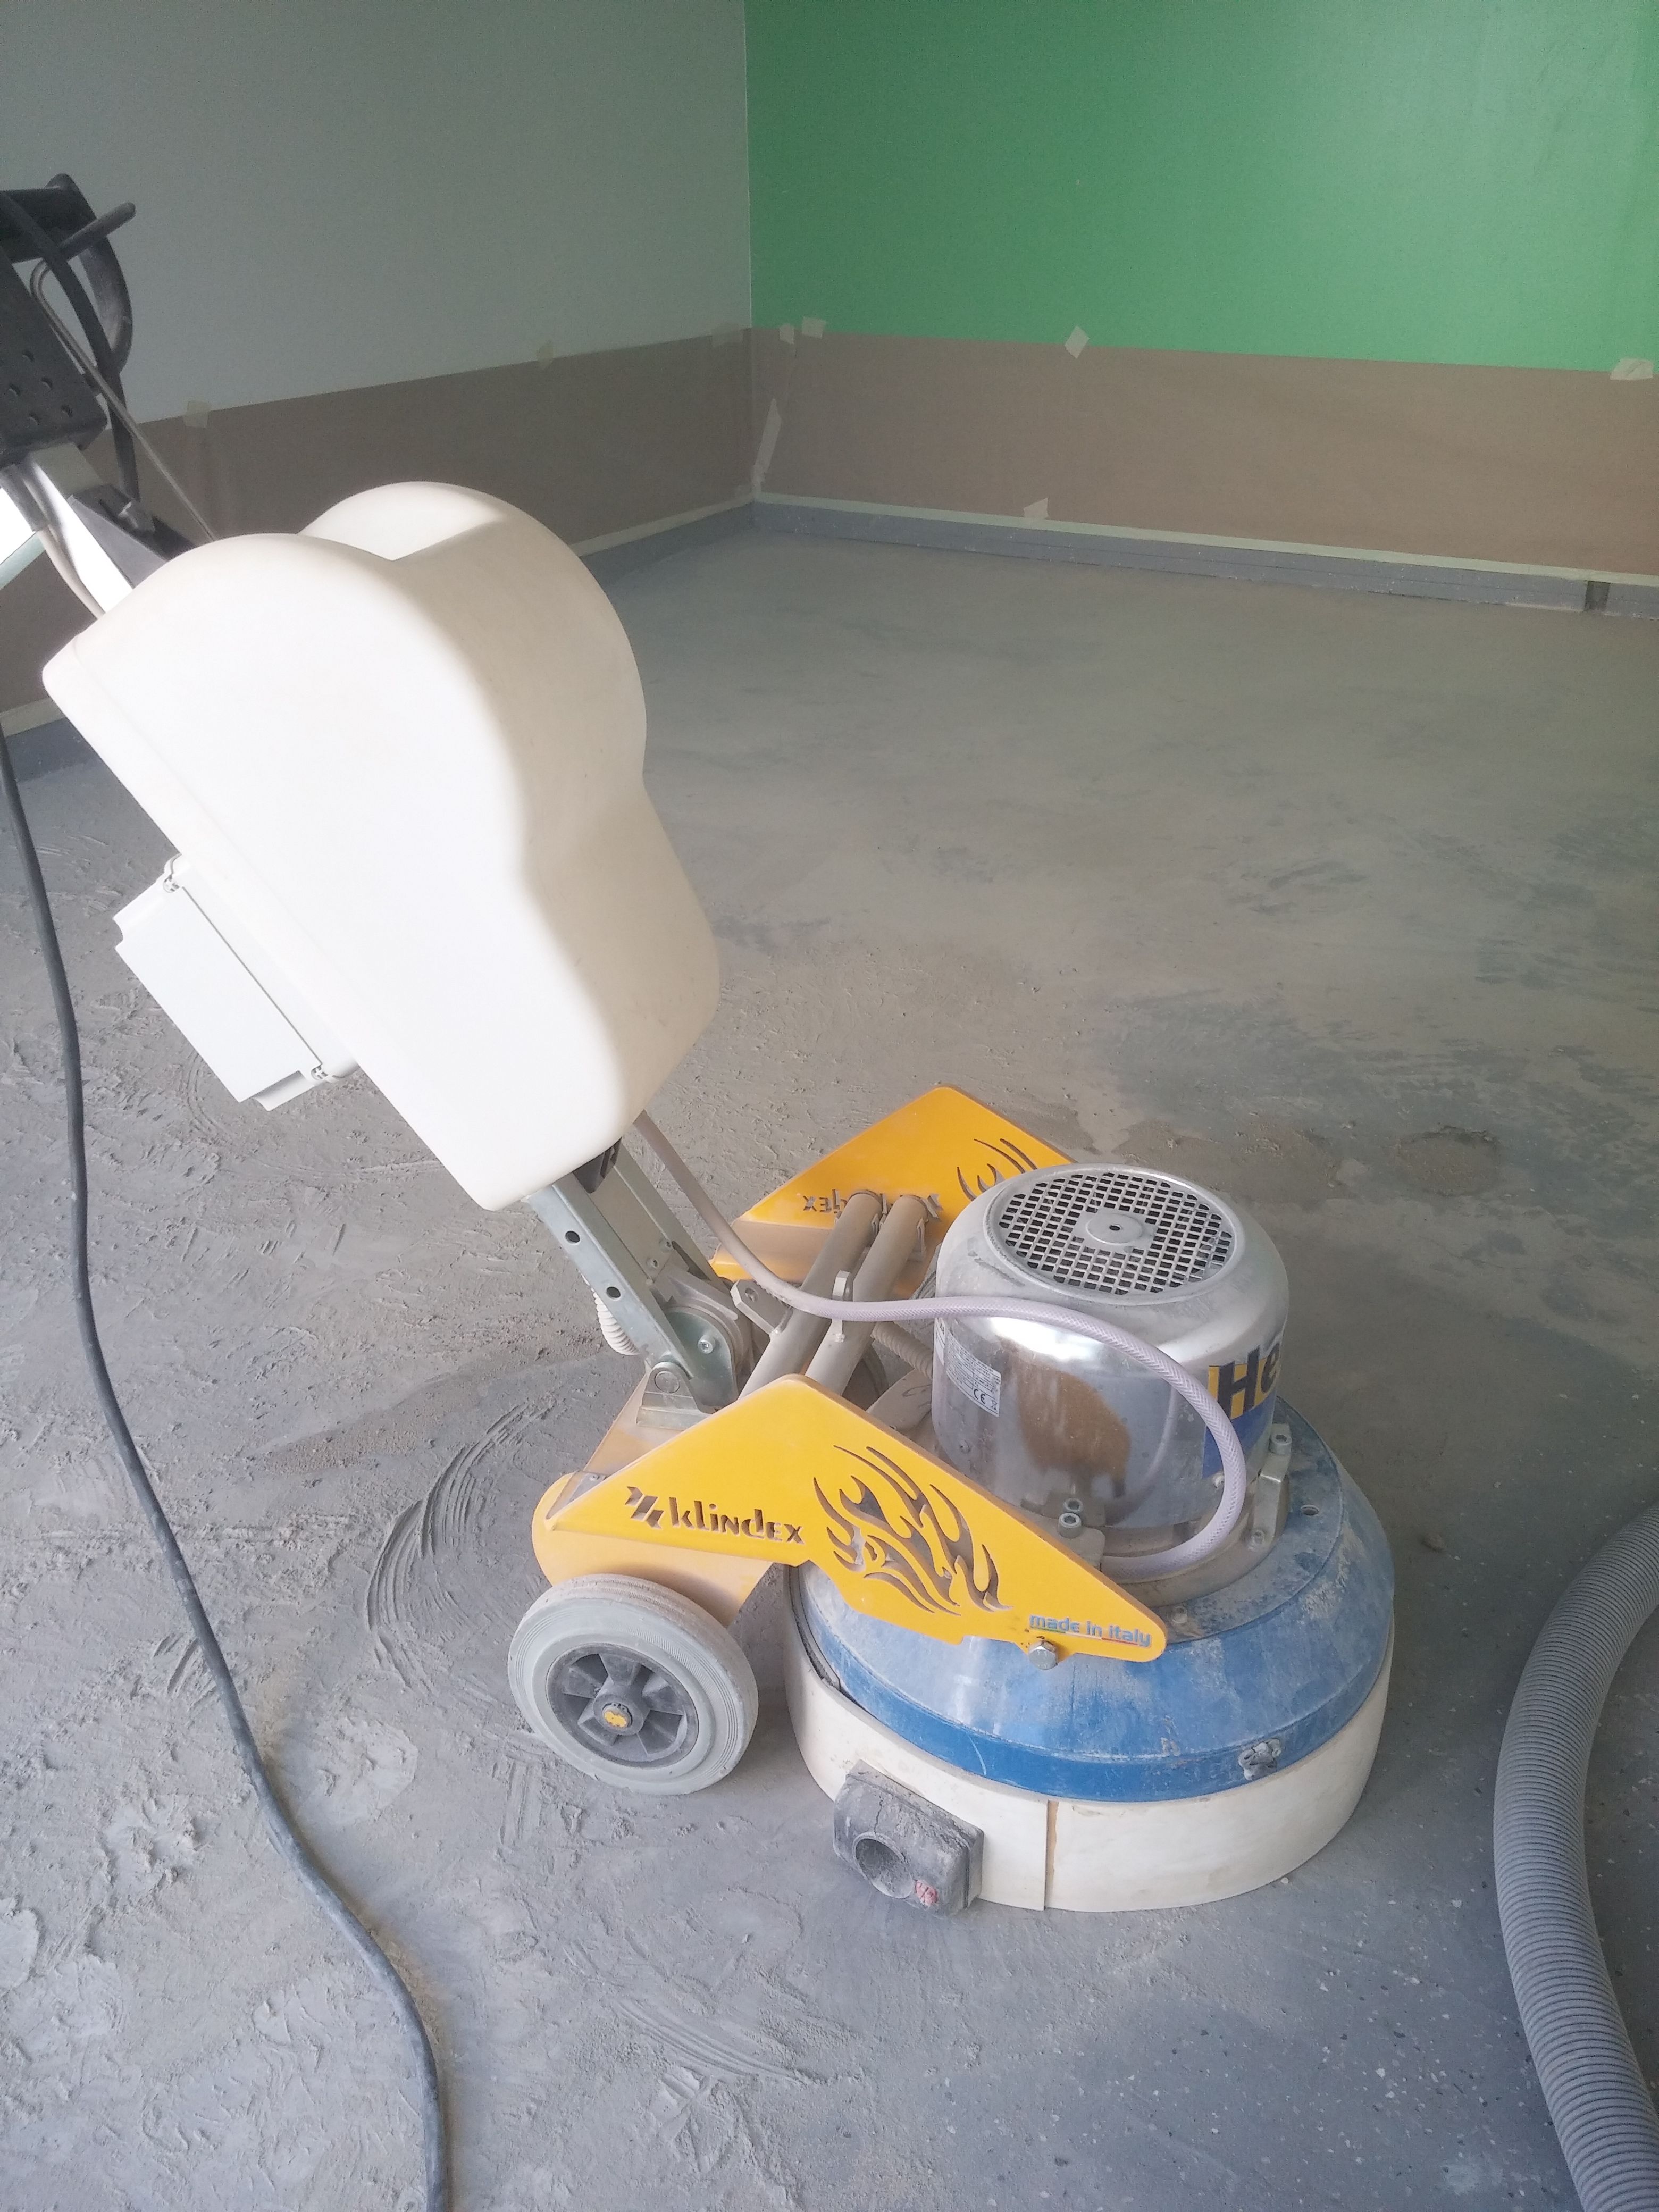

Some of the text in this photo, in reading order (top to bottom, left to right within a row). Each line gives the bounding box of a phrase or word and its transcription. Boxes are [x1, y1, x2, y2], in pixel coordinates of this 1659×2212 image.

[974, 1388, 986, 1405] CE
[1029, 1614, 1151, 1647] made in italy
